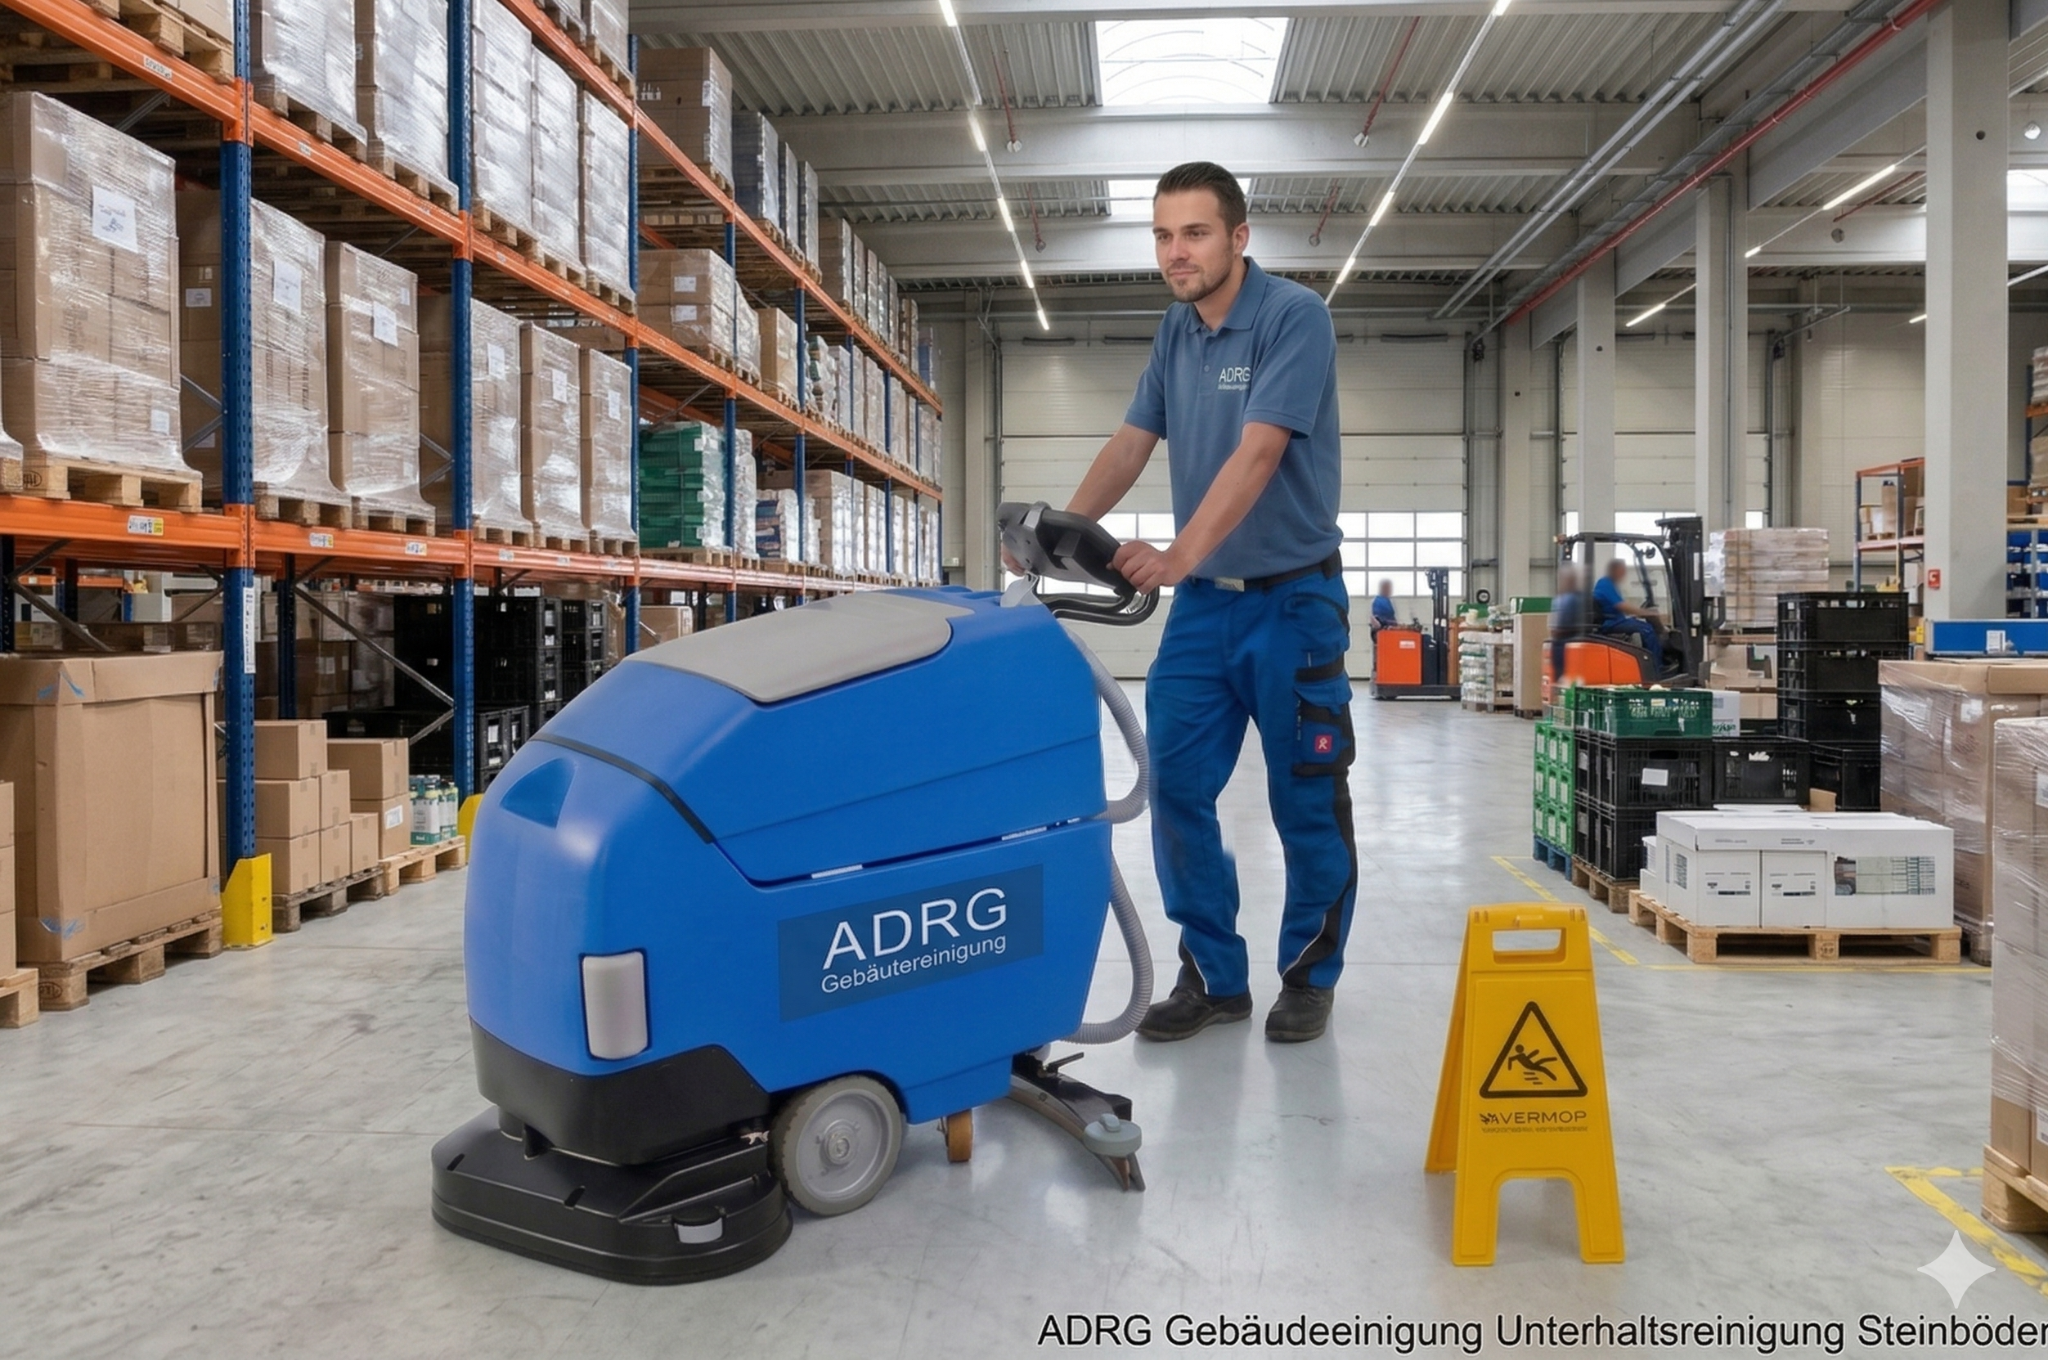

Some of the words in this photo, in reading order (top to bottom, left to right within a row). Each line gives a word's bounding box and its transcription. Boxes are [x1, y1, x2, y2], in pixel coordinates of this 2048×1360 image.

[1219, 366, 1250, 382] ADRG
[822, 887, 1007, 970] ADRG
[821, 935, 1006, 993] Gebäutereinigung
